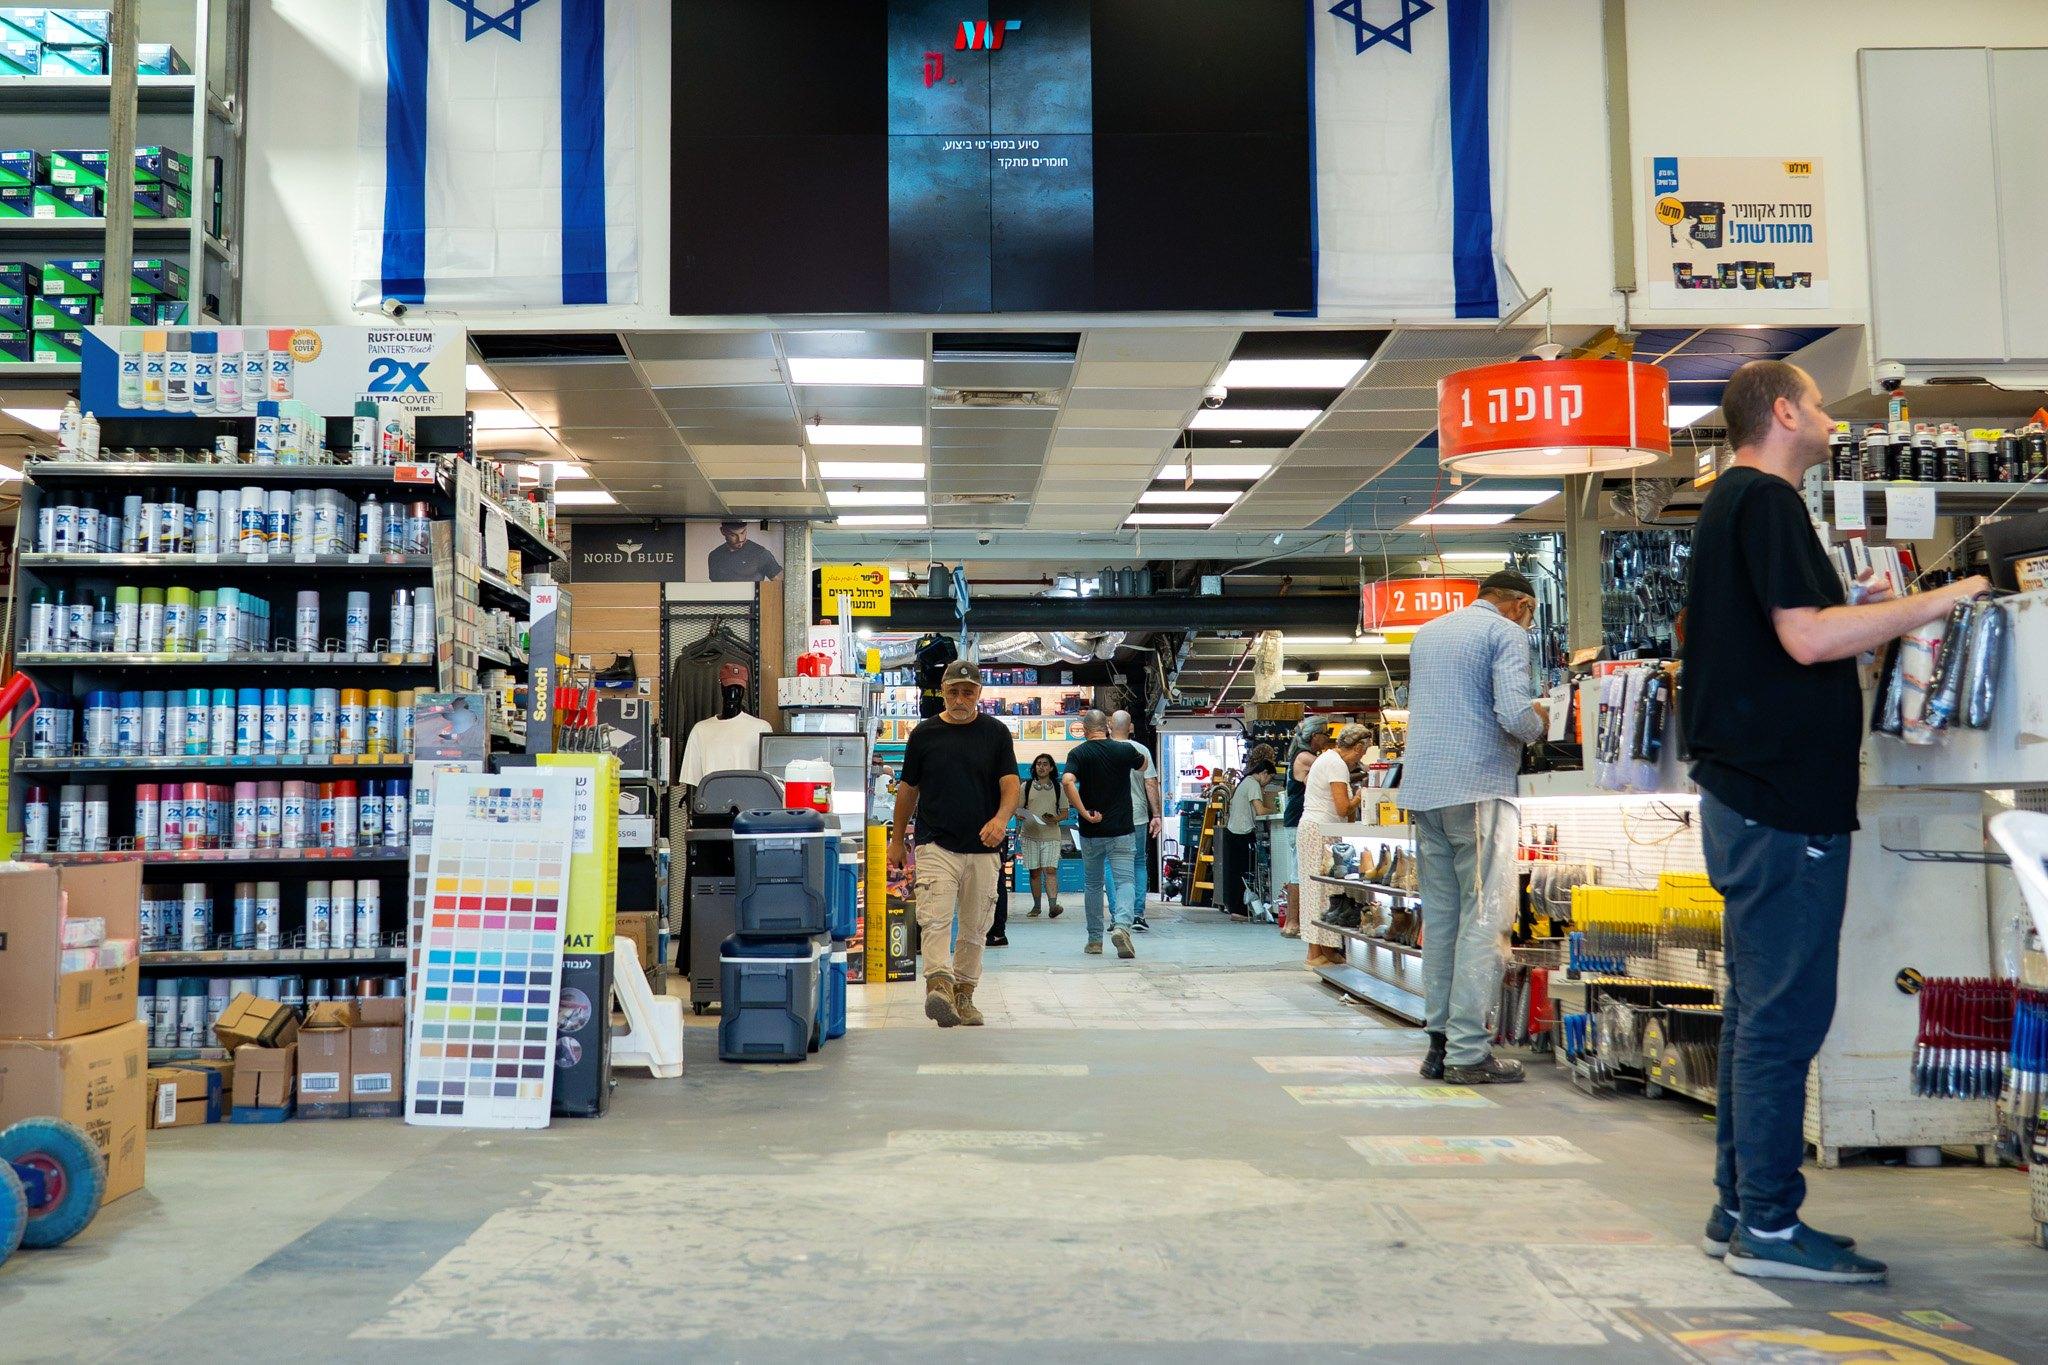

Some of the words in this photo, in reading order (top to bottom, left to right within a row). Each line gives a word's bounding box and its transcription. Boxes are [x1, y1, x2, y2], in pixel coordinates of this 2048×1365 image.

[942, 140, 972, 151] ביצוע,
[975, 140, 1015, 151] במפרטי
[1018, 140, 1040, 150] סיוע
[998, 157, 1029, 170] מתקד
[1033, 157, 1068, 167] חומרים
[1732, 203, 1775, 222] אקווניר
[1780, 203, 1812, 218] סדרת
[1729, 221, 1813, 244] מתחדשת!
[124, 361, 139, 372] 2X
[148, 362, 163, 373] 2X
[170, 361, 186, 373] 2X
[196, 364, 212, 374] 2X
[222, 363, 238, 373] 2X
[247, 361, 262, 371] 2X
[273, 361, 289, 371] 2X
[367, 357, 430, 392] 2X
[1461, 388, 1474, 428] 1
[1488, 384, 1582, 427] קופה
[258, 424, 272, 433] 2X
[583, 554, 623, 563] NORD
[638, 553, 675, 563] BLUE
[857, 586, 884, 598] פירזול
[536, 595, 552, 604] 3M
[1393, 590, 1406, 612] 2
[1414, 591, 1465, 613] קופה
[812, 638, 836, 649] AED
[533, 667, 548, 722] Scotch
[264, 714, 275, 722] 2X
[168, 808, 182, 816] 2X
[186, 807, 201, 817] 2X
[257, 907, 269, 916] 2X
